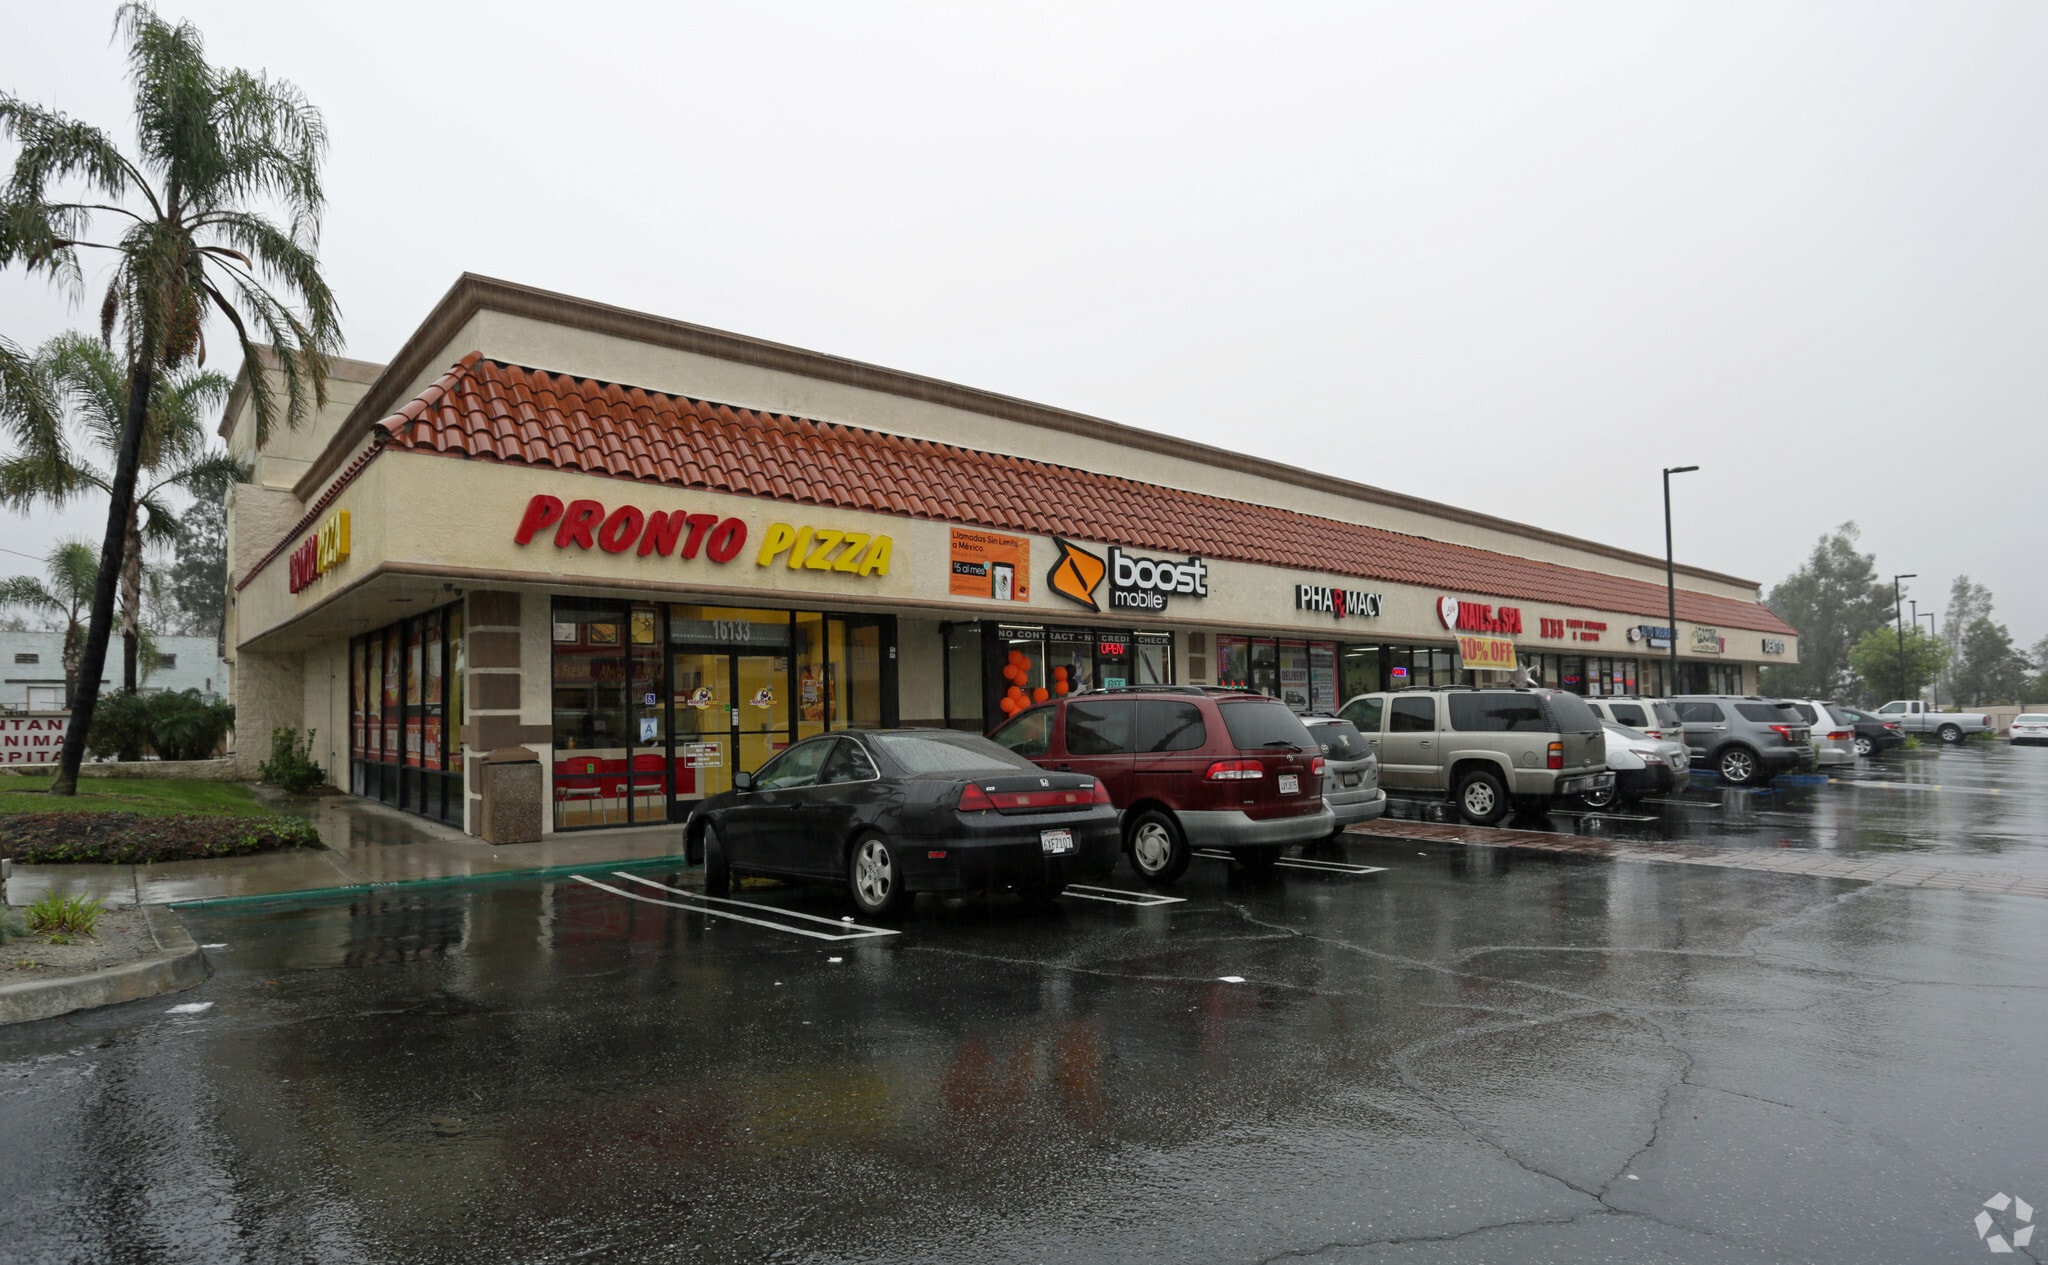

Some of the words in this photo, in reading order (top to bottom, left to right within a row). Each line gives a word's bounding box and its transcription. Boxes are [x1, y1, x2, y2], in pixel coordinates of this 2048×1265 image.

[514, 495, 748, 563] PRONTO
[756, 522, 893, 577] PIZZA
[952, 531, 986, 543] Llamadas
[987, 536, 998, 544] Sin
[962, 565, 970, 573] al
[970, 567, 986, 575] mes
[1114, 549, 1206, 595] boost
[1115, 590, 1163, 609] mobile
[1456, 601, 1493, 632] NAILS
[1499, 606, 1523, 633] SPA
[713, 618, 750, 641] 16133
[999, 630, 1013, 638] NO
[1101, 634, 1130, 642] CREDI
[1138, 636, 1169, 644] CHECK
[1101, 642, 1124, 654] OPEN
[1460, 637, 1488, 661] 10%
[1490, 641, 1513, 662] OFF
[1282, 670, 1306, 681] DELIVERY
[0, 735, 65, 747] NIMA
[0, 751, 62, 763] PITA
